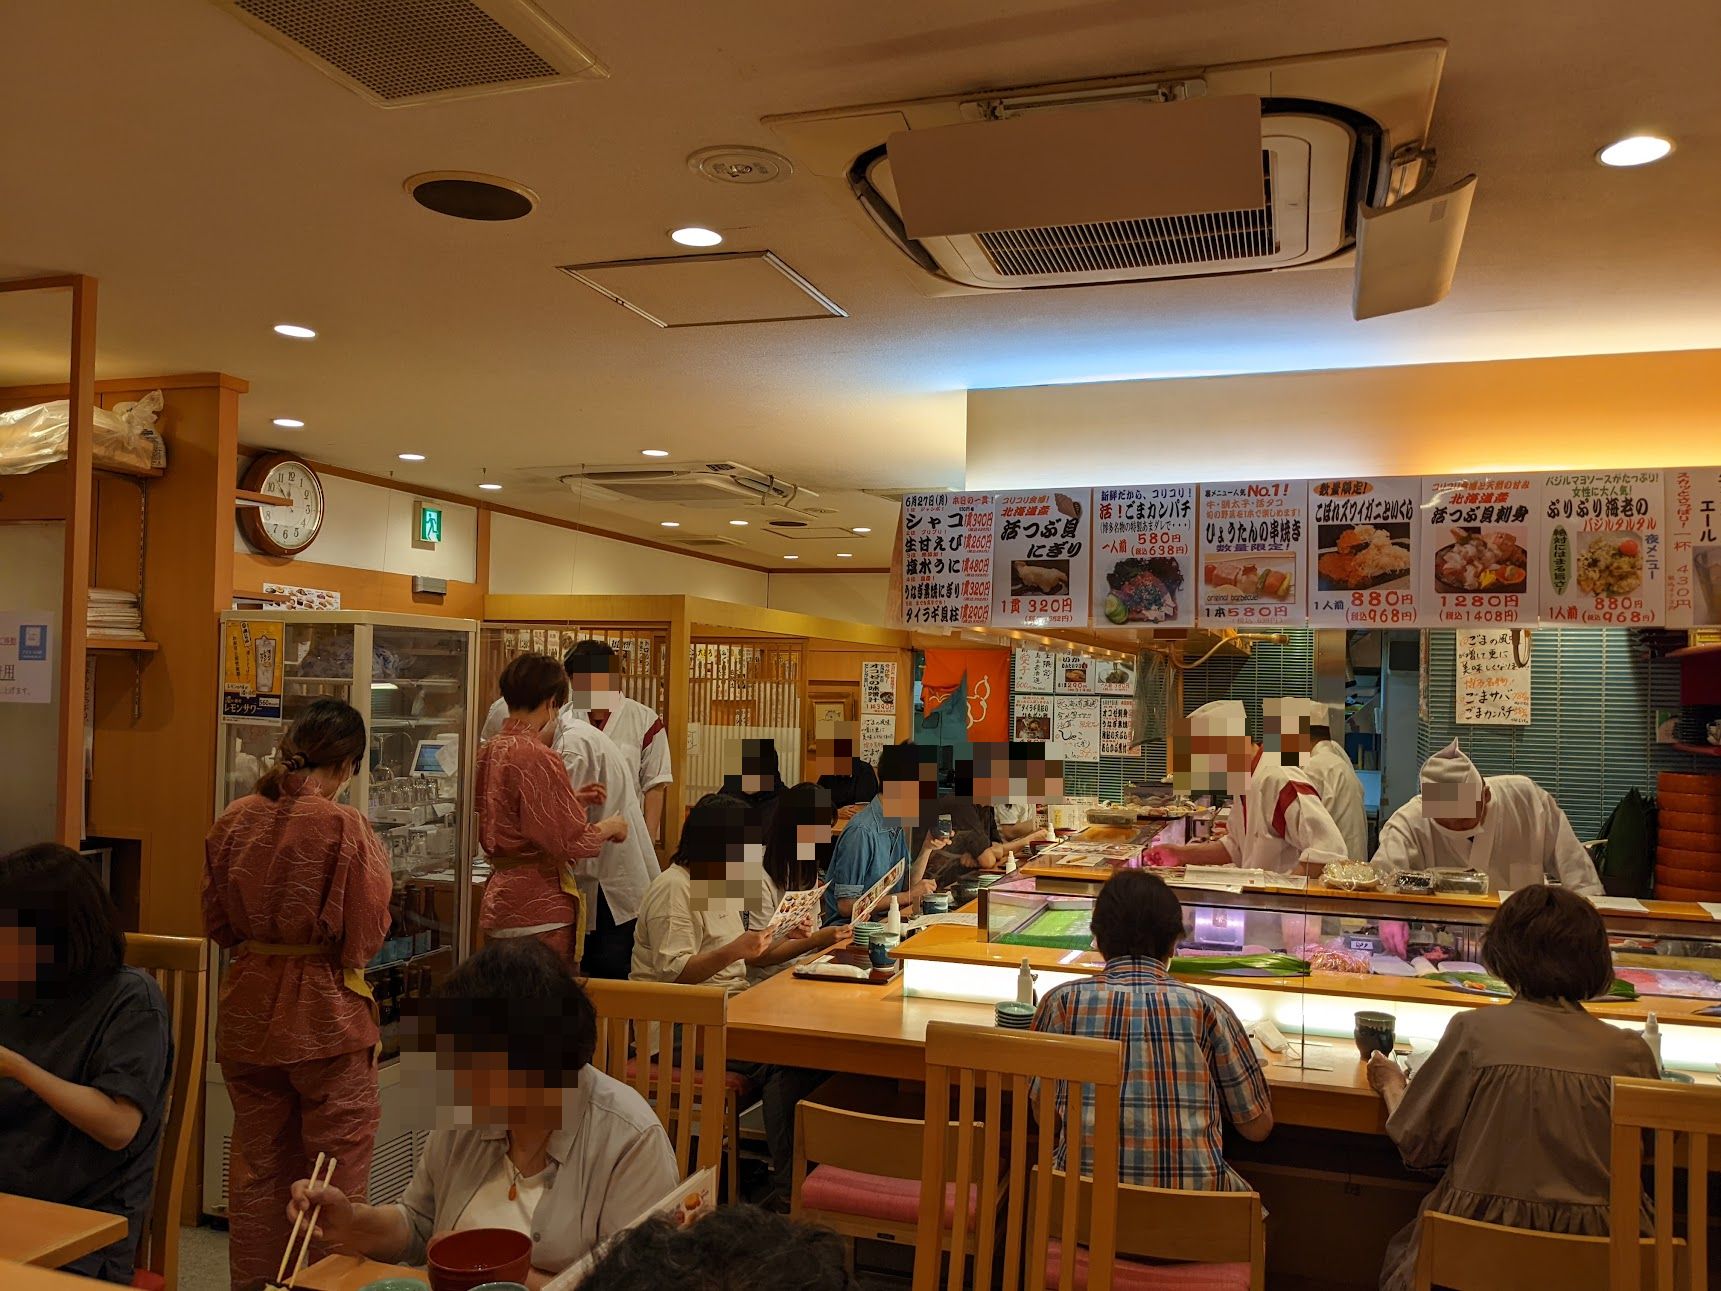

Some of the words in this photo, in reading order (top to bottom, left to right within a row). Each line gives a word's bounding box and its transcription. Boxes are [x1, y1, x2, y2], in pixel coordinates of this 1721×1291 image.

[278, 473, 284, 482] 11
[288, 472, 296, 482] 12
[299, 478, 303, 488] 1
[1545, 473, 1659, 486] バジルマヨソースがたっぷり!
[268, 482, 275, 492] 10
[1319, 482, 1368, 496] 数量限定!
[1572, 485, 1632, 498] 女性に大人気!
[304, 490, 309, 500] 2
[905, 494, 948, 507] 6月27日(月)
[1449, 492, 1509, 504] 北海道産
[306, 505, 311, 514] 3
[1001, 505, 1051, 517] 北海道産
[1315, 498, 1413, 522] こぼれズワイガニといくら
[1431, 505, 1529, 524] 活つぶ貝刺身
[1547, 497, 1649, 519] ぷりぷり海老の
[266, 511, 271, 520] 8
[905, 513, 963, 530] シャコ
[1700, 500, 1718, 543] エール
[273, 524, 278, 534] 7
[300, 518, 306, 527] 4
[1001, 517, 1081, 540] 活つぶ貝
[1583, 517, 1657, 531] バジルタルタル
[282, 530, 288, 540] 6
[294, 528, 299, 538] 5
[1206, 518, 1301, 544] ひょうたんの串焼き
[905, 534, 963, 552] 生甘えび
[963, 533, 992, 550] 1貫260円
[1138, 532, 1181, 545] 580円
[1027, 541, 1082, 558] にぎり
[1102, 539, 1127, 554] 一人前
[1216, 543, 1290, 552] 数量限定!
[1645, 533, 1660, 580] 夜メニュー
[906, 558, 960, 575] 塩水うに
[962, 557, 990, 573] 1貫480円
[961, 580, 990, 597] 1貫320円
[1029, 597, 1072, 613] 320円
[1351, 591, 1413, 606] 880円
[1440, 595, 1518, 607] 1280円
[1595, 597, 1643, 610] 880円
[906, 605, 960, 623] タイラギ貝柱
[1314, 600, 1344, 610] 1人前
[1346, 607, 1417, 623] (税込968円)
[1439, 609, 1518, 622] (税込1408円)
[1549, 605, 1578, 620] 1人前
[1582, 609, 1655, 623] (税込968円)
[1468, 634, 1513, 646] ごまの風
[1465, 689, 1513, 704] ごまサバ
[224, 703, 263, 714] レモンサワー
[1465, 706, 1514, 720] ごまカンパチ
